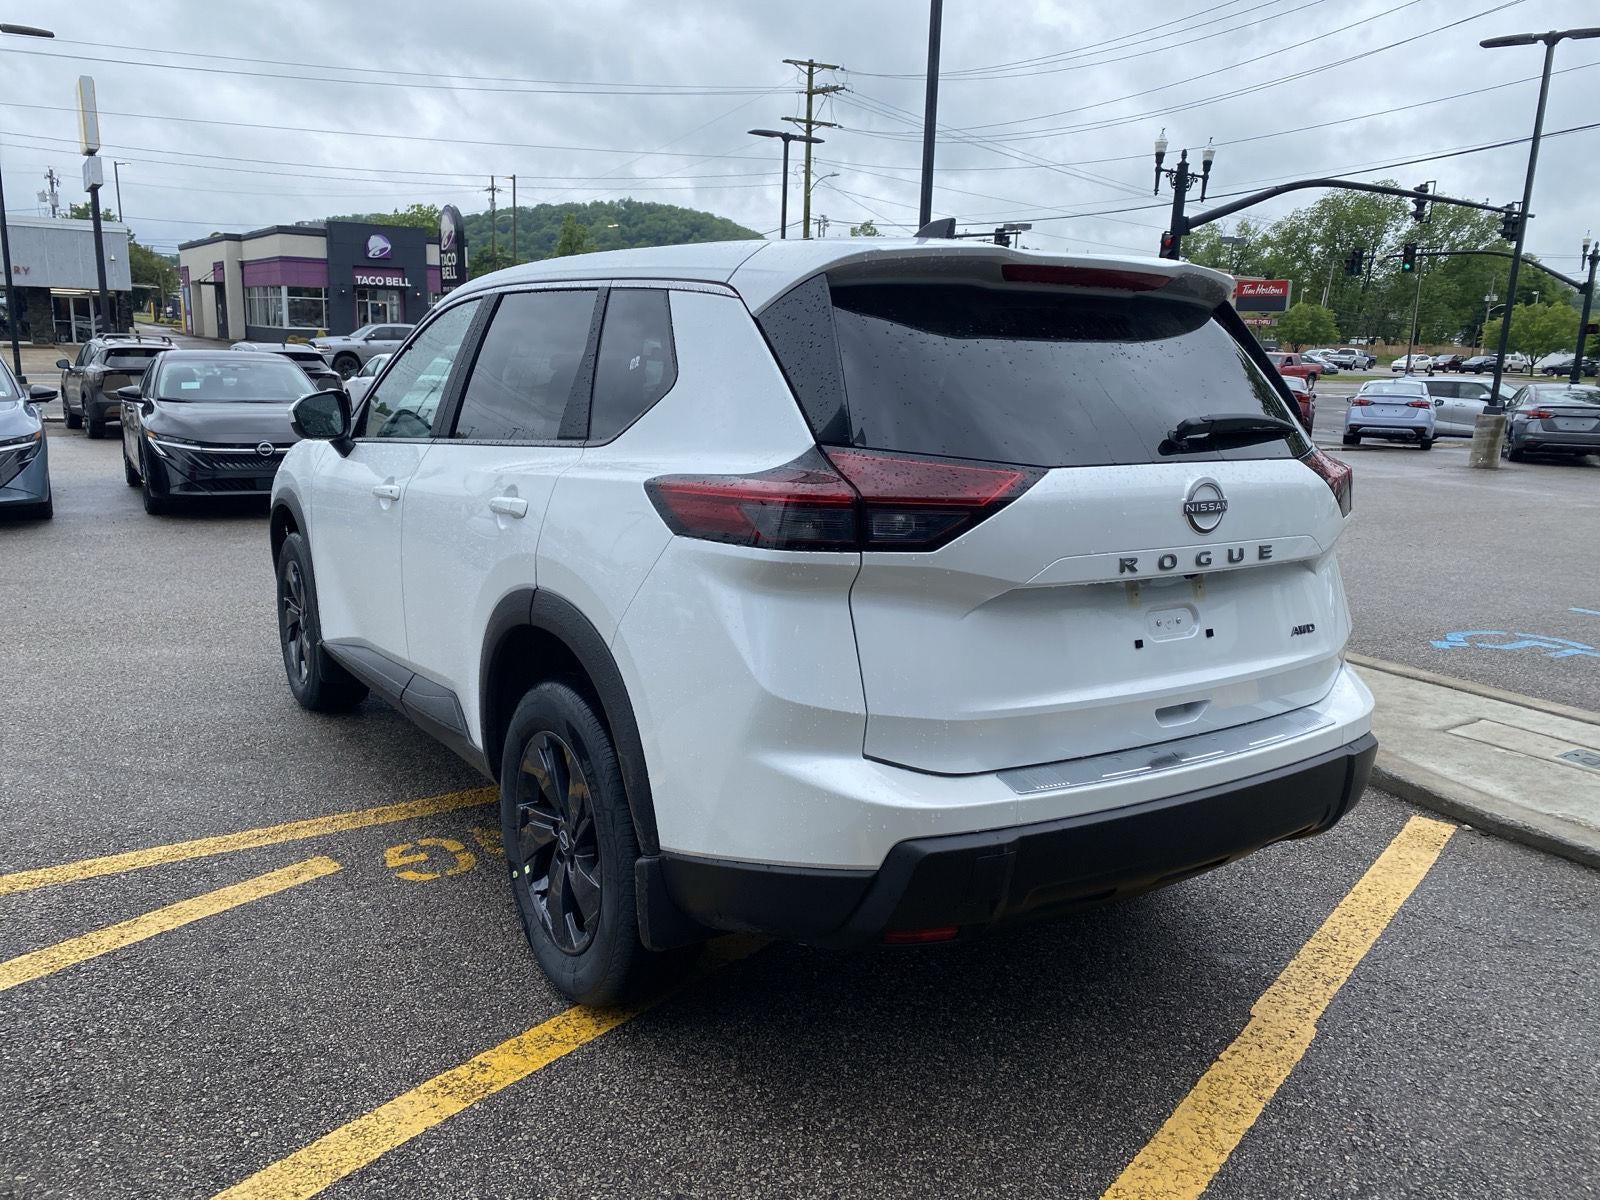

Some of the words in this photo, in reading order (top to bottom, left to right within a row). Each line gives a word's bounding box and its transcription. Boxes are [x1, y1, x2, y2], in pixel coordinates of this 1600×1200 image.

[440, 252, 457, 266] TACO
[442, 266, 458, 279] BELL
[355, 275, 385, 286] TACO
[385, 276, 412, 287] BELL
[1242, 284, 1255, 294] Tim
[1255, 284, 1283, 294] Hortons
[1185, 502, 1228, 512] NISSAN
[1118, 544, 1274, 575] ROGUE
[1290, 623, 1316, 638] AWD
